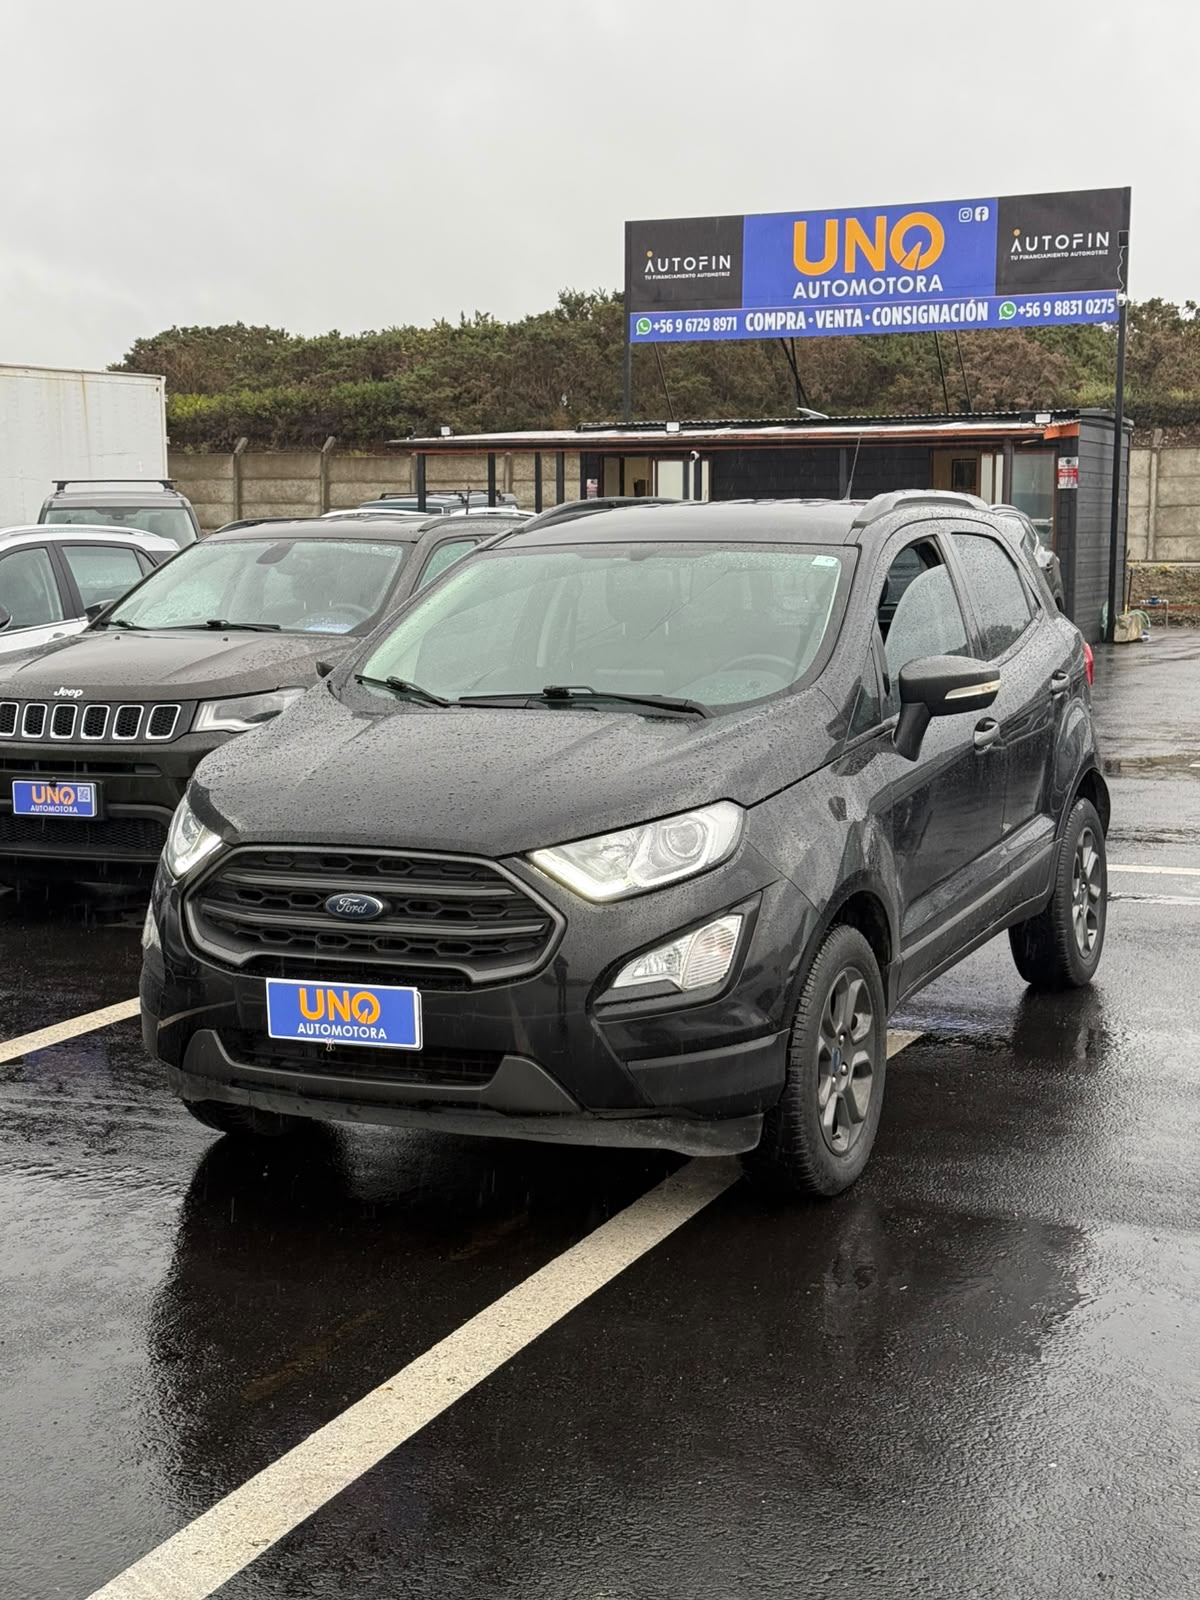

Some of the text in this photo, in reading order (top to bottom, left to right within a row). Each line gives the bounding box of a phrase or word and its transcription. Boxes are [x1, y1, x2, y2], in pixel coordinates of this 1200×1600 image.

[793, 211, 945, 276] UNO
[1011, 230, 1109, 253] AUTOFIN
[644, 251, 731, 273] AUTOFIN
[1019, 251, 1068, 260] FINANCIAMIENTO
[1070, 249, 1108, 257] AUTOMOTRIZ
[793, 274, 944, 299] AUTOMOTORA
[745, 299, 989, 331] COMPRA VENTA CONSIGNACIÓN
[1018, 298, 1115, 317] +56 9 8831 0275
[653, 316, 737, 333] +56 9 6729 8971
[54, 687, 83, 698] Jeep
[32, 785, 75, 805] UNO
[30, 804, 78, 813] AUTOMOTORA
[336, 897, 367, 914] Ford
[299, 988, 380, 1024] UNO
[297, 1022, 387, 1039] AUTOMOTORA
